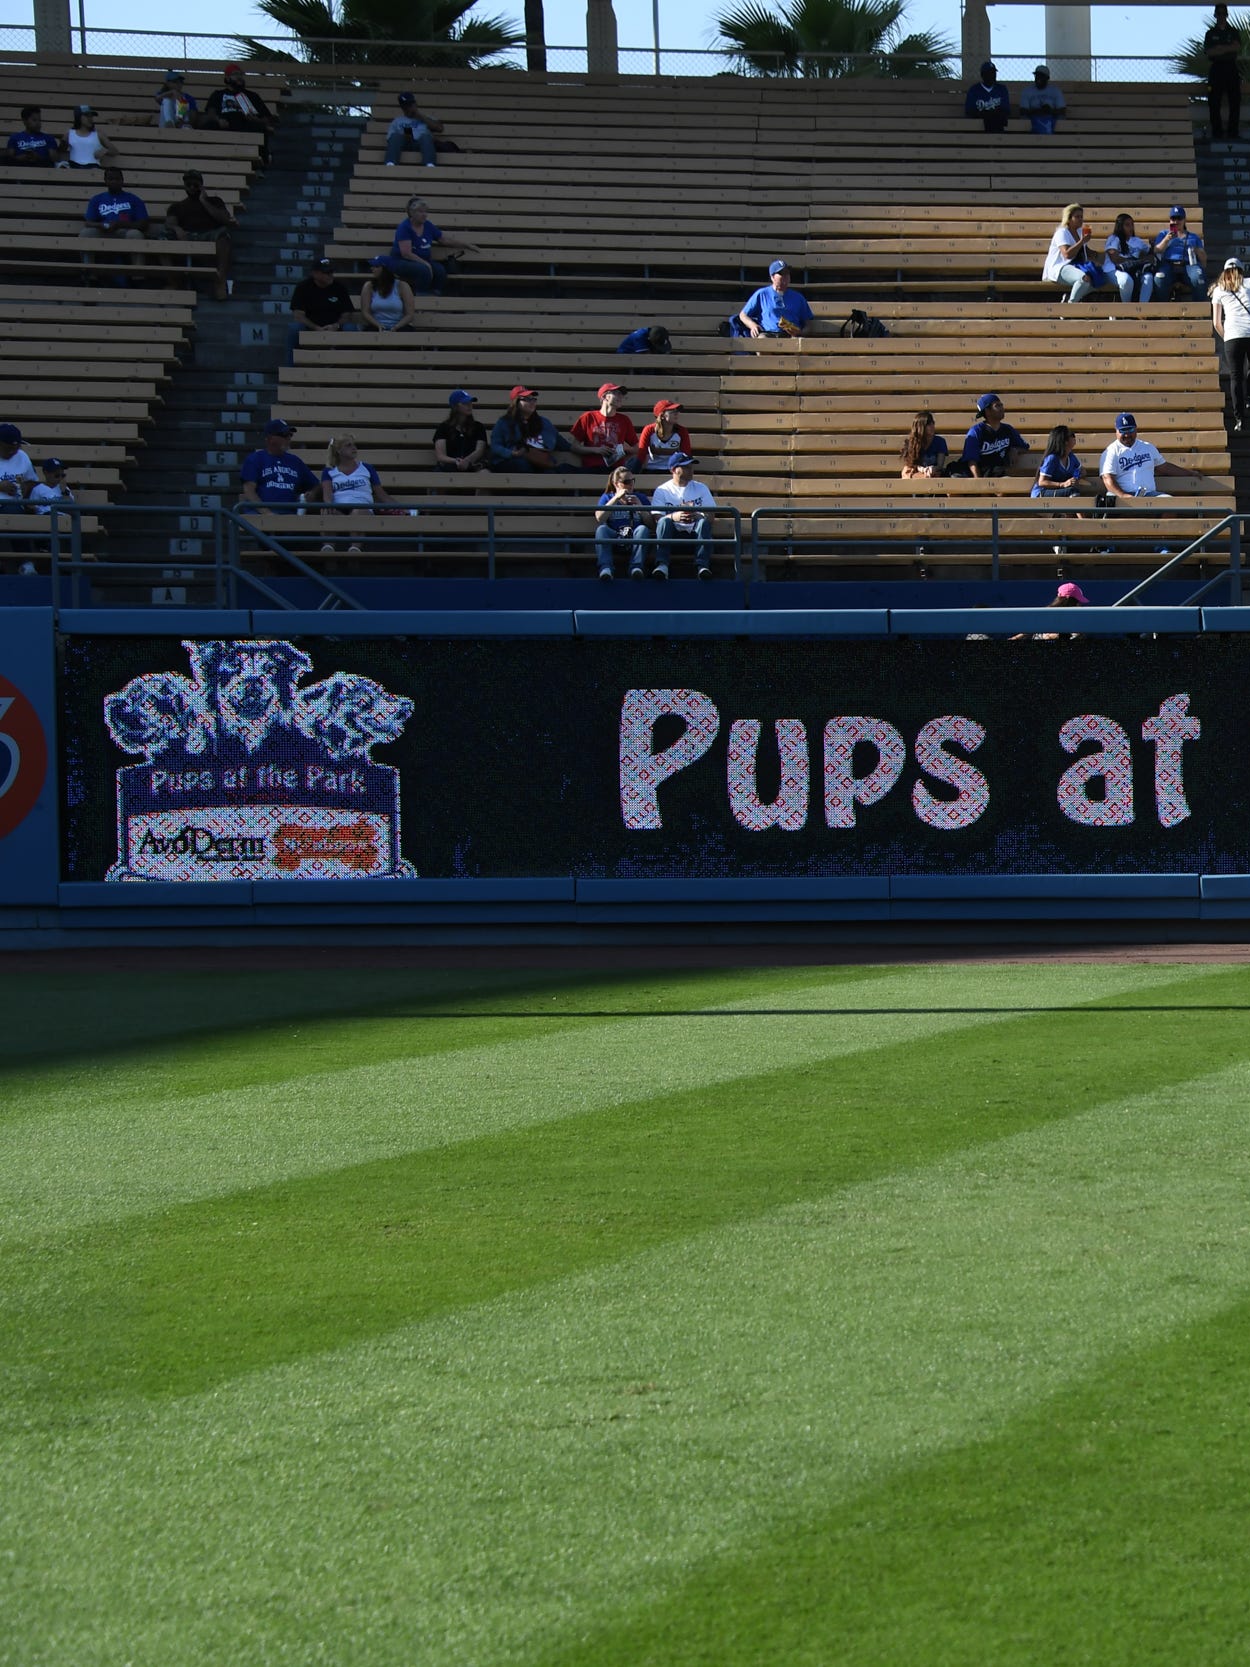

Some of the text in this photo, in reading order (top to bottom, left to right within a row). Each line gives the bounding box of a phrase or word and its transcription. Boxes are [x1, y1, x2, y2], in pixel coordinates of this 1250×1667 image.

[98, 202, 131, 215] Dodgers
[1118, 453, 1152, 471] Dodgers
[332, 479, 368, 492] Dodgers
[619, 688, 991, 832] Pups
[1057, 691, 1201, 829] at
[150, 763, 368, 798] Pups at the Park
[137, 824, 266, 858] AvoDerm
